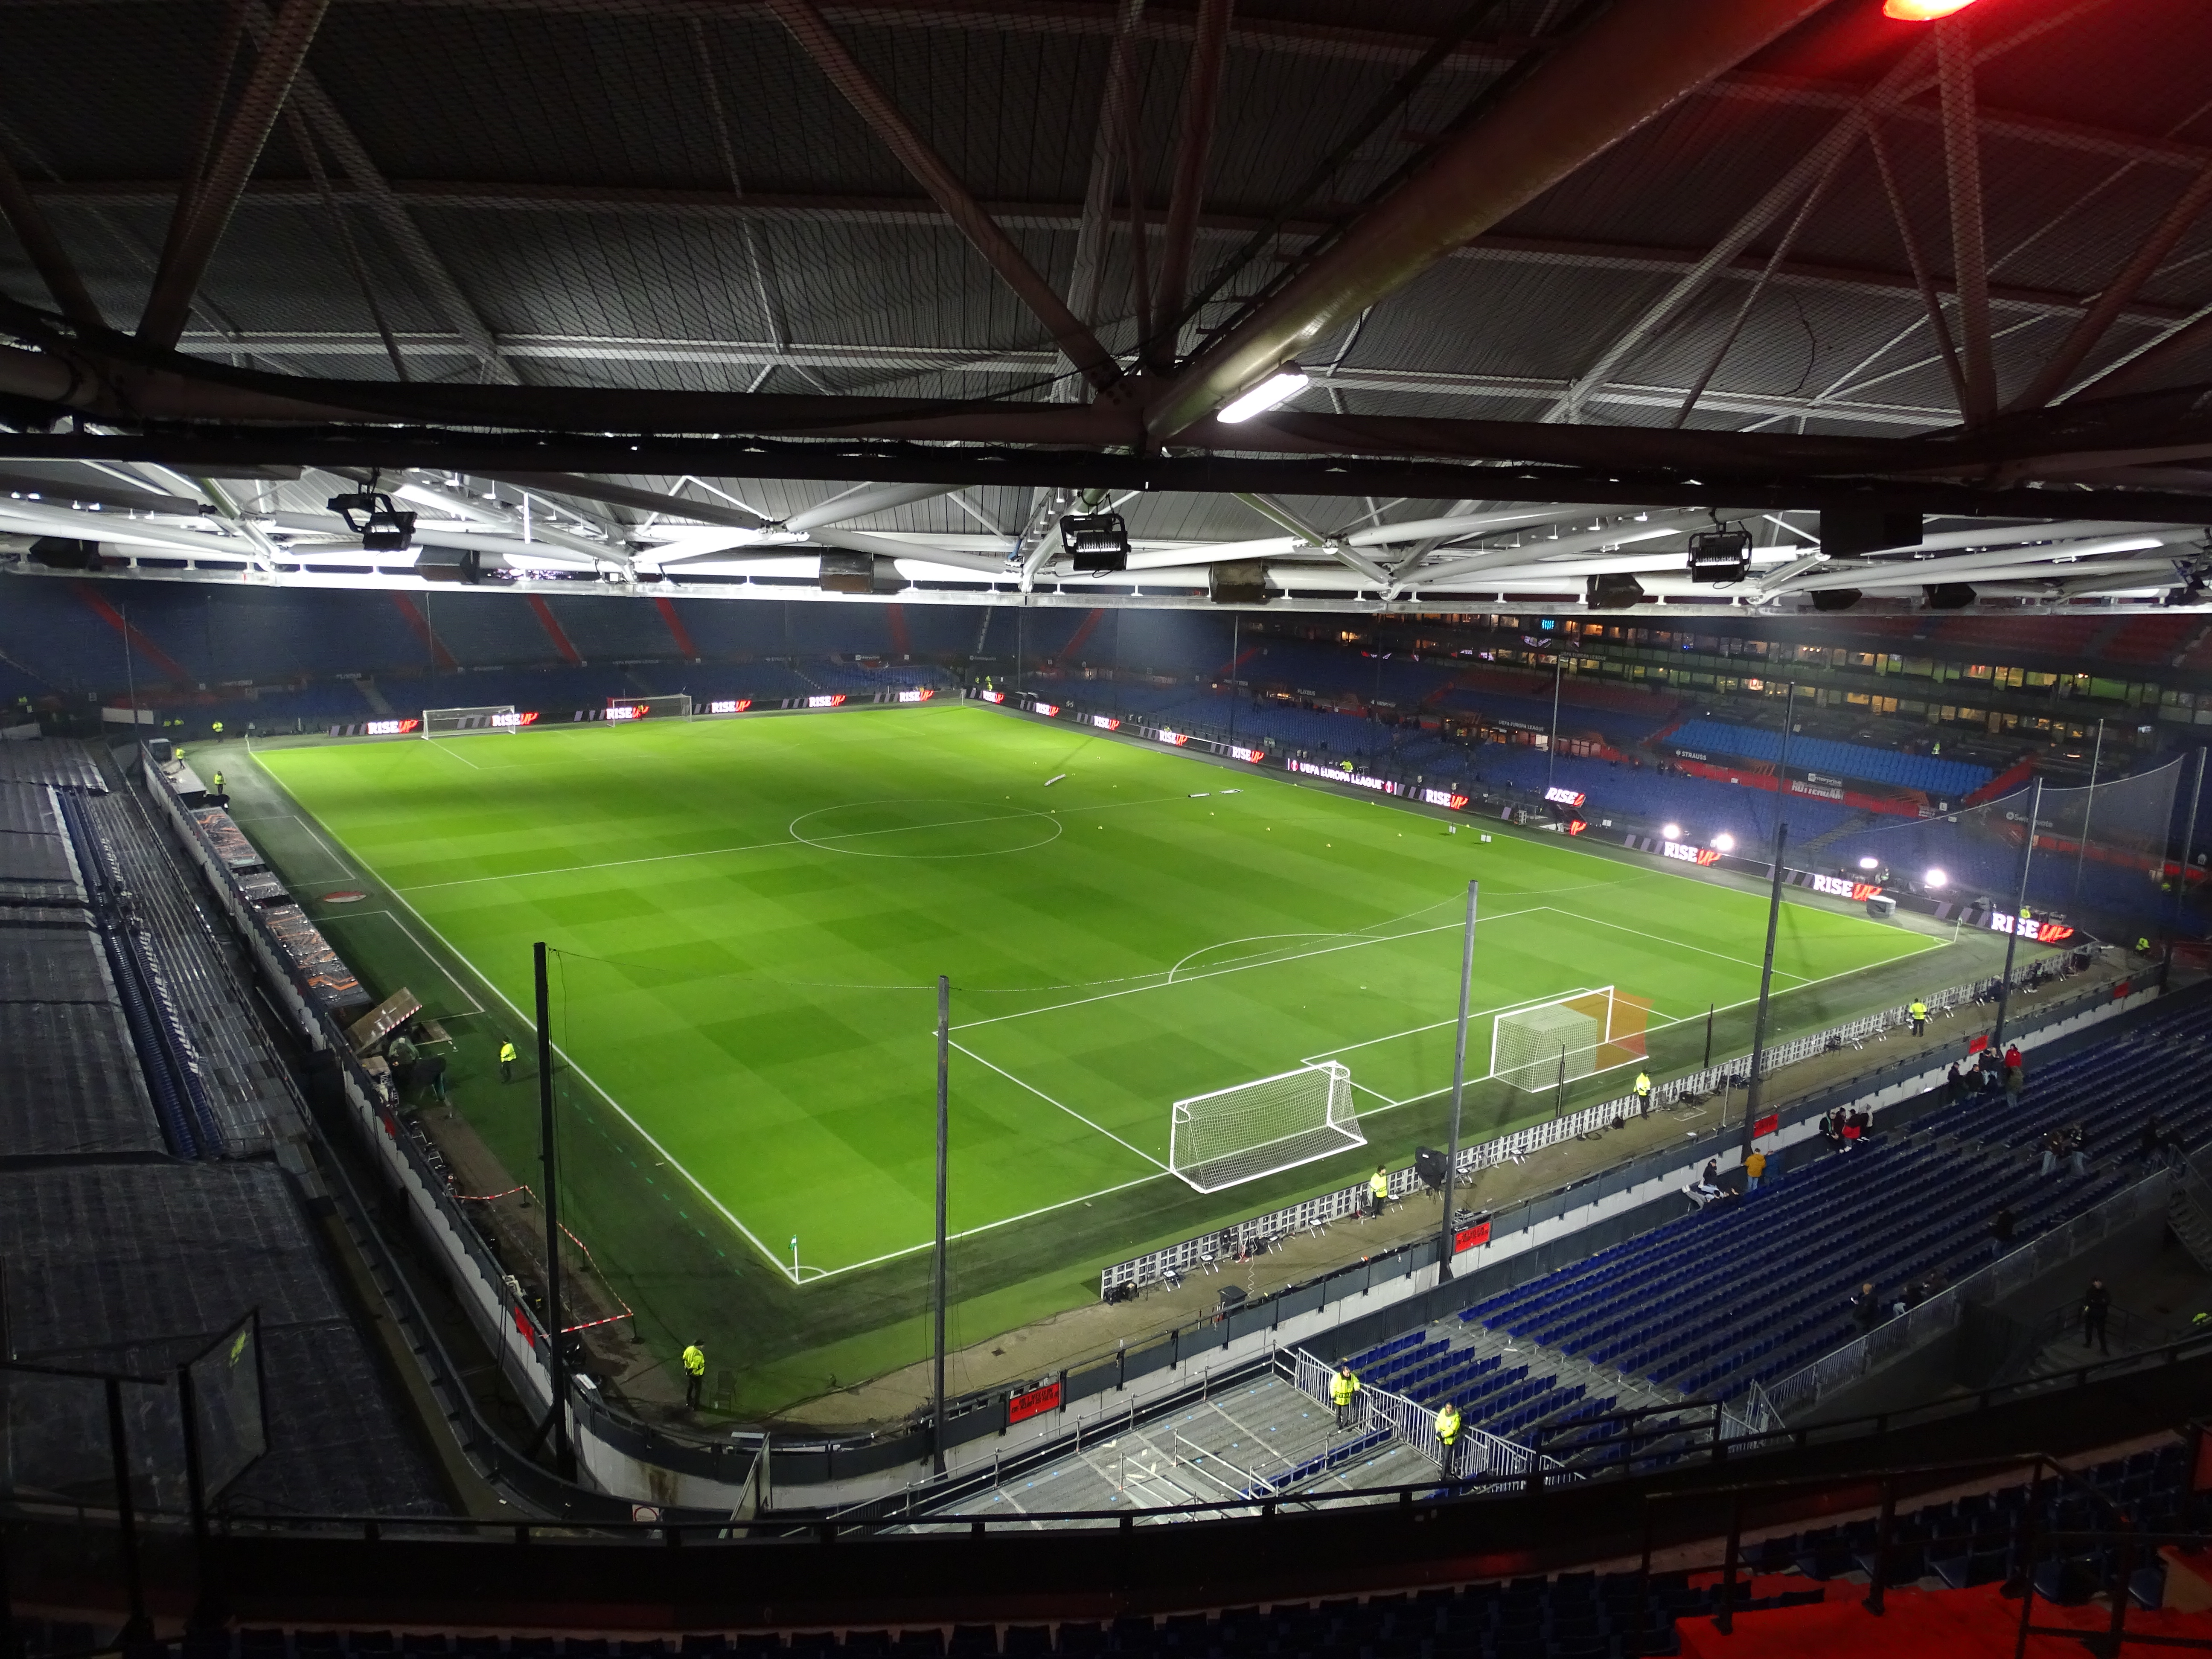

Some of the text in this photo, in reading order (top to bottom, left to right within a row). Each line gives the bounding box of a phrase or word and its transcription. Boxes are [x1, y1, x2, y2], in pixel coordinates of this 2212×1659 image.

[809, 696, 831, 707] RISE
[899, 691, 920, 702] RISE
[983, 690, 996, 703] RISE
[606, 707, 632, 719] RISE
[711, 701, 736, 713] RISE
[1036, 702, 1050, 715] RISE
[492, 713, 521, 727] RISE
[1094, 715, 1109, 729] RISE
[368, 721, 399, 735] RISE
[1159, 730, 1176, 745] RISE
[1232, 746, 1251, 761] RISE
[1682, 751, 1706, 760] STRAUSS
[1300, 762, 1382, 790] UEFA EUROPA LEAGUE
[1426, 789, 1451, 807] RISE
[1545, 787, 1579, 805] RISE
[1664, 841, 1698, 862] RISE
[1813, 874, 1854, 898] RISE
[1991, 912, 2040, 939] RISE
